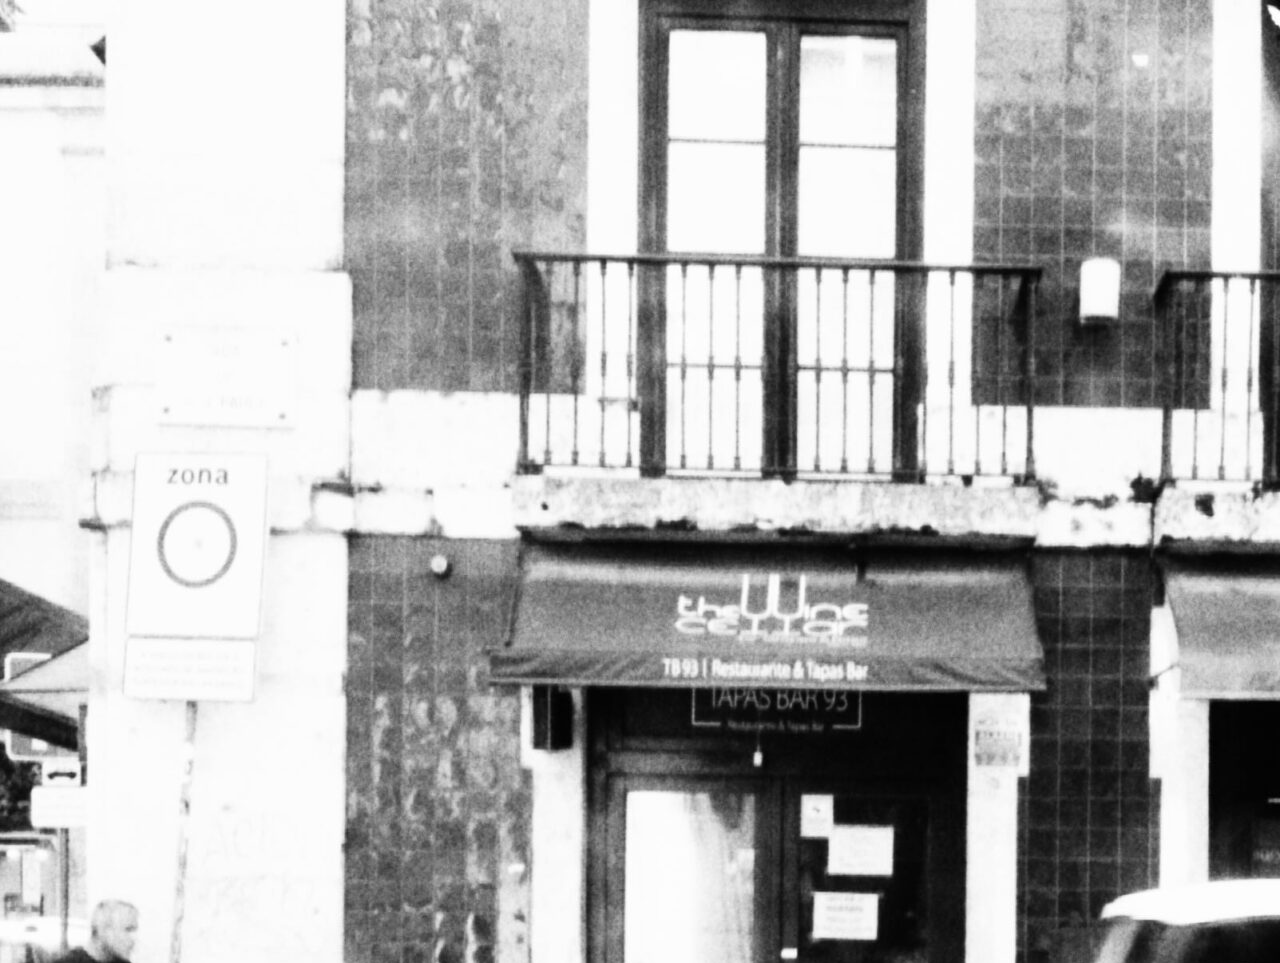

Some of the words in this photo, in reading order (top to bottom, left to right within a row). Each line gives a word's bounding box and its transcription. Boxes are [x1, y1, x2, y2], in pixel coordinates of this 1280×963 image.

[167, 467, 229, 485] zona
[711, 657, 791, 679] Restaurante
[806, 659, 844, 683] Tapas
[846, 660, 869, 681] Bar
[775, 688, 819, 712] BAR
[823, 689, 849, 713] 93
